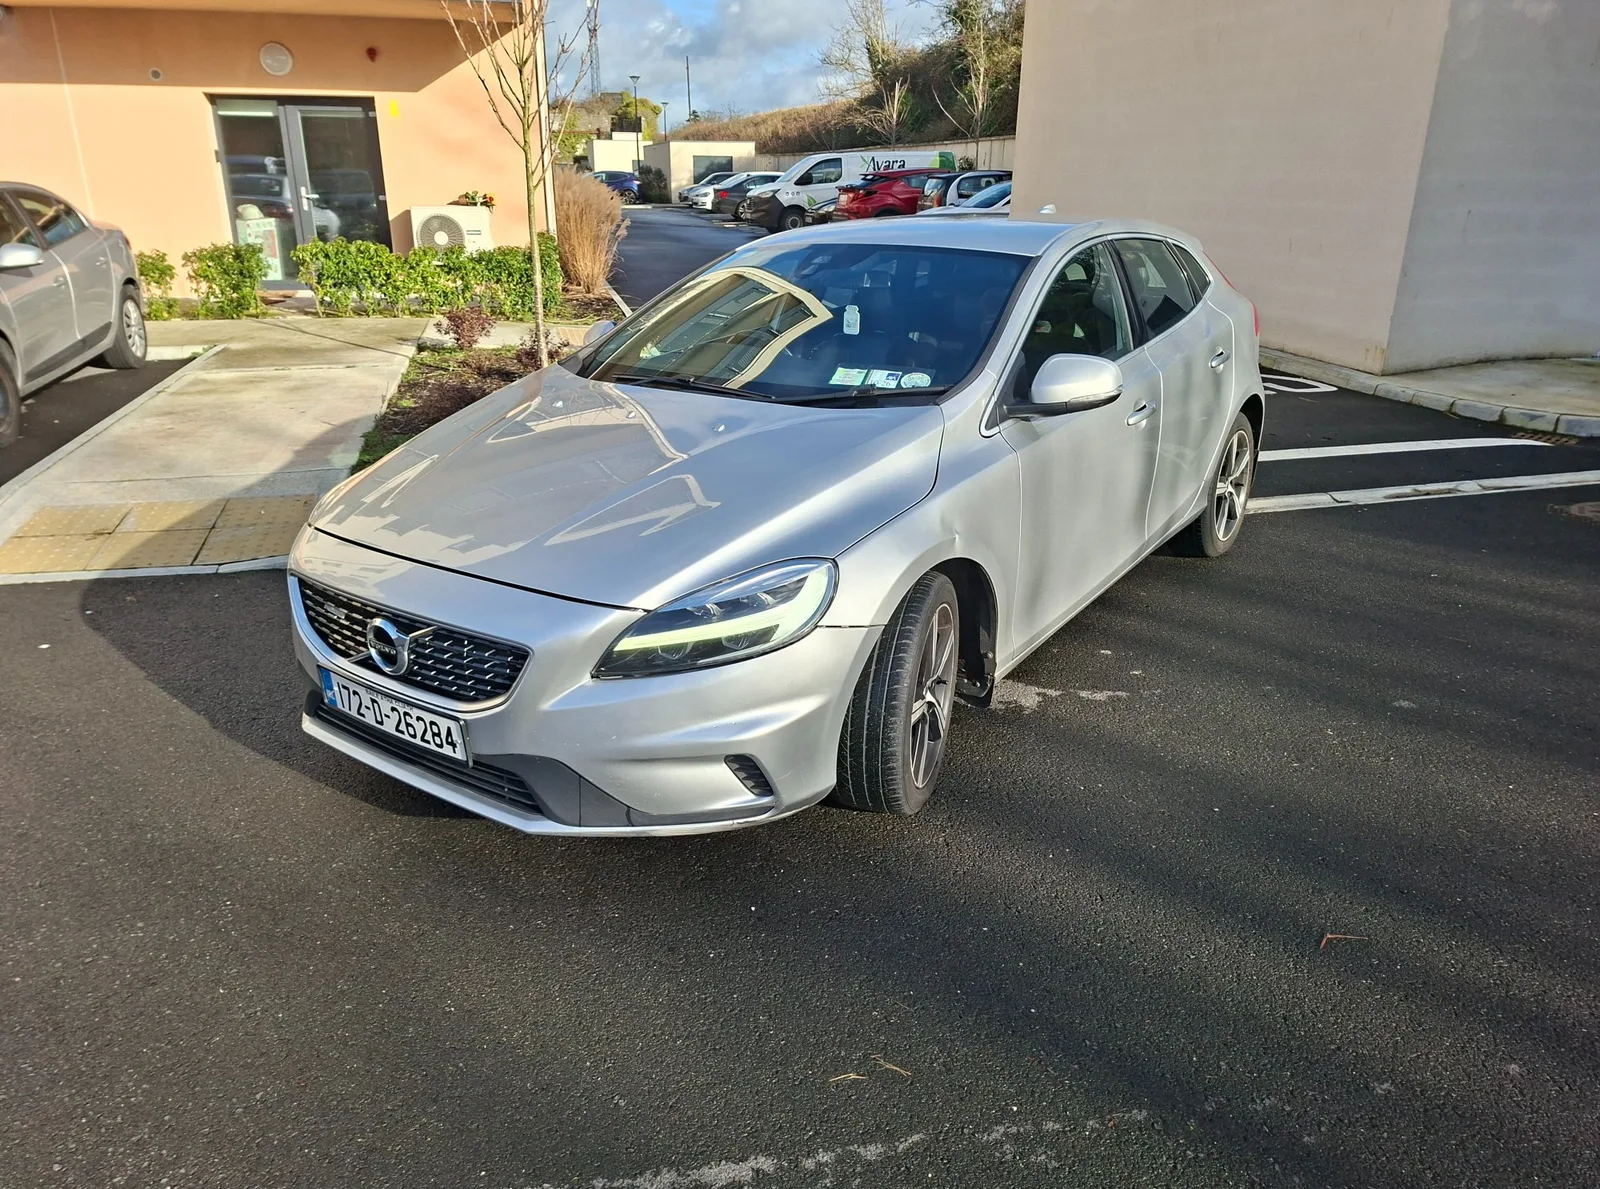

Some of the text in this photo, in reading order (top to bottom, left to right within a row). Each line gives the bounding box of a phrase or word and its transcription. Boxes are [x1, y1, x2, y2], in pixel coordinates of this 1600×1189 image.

[865, 156, 906, 172] Avara
[370, 640, 397, 655] VOLVO
[336, 681, 458, 755] 172-D-26284
